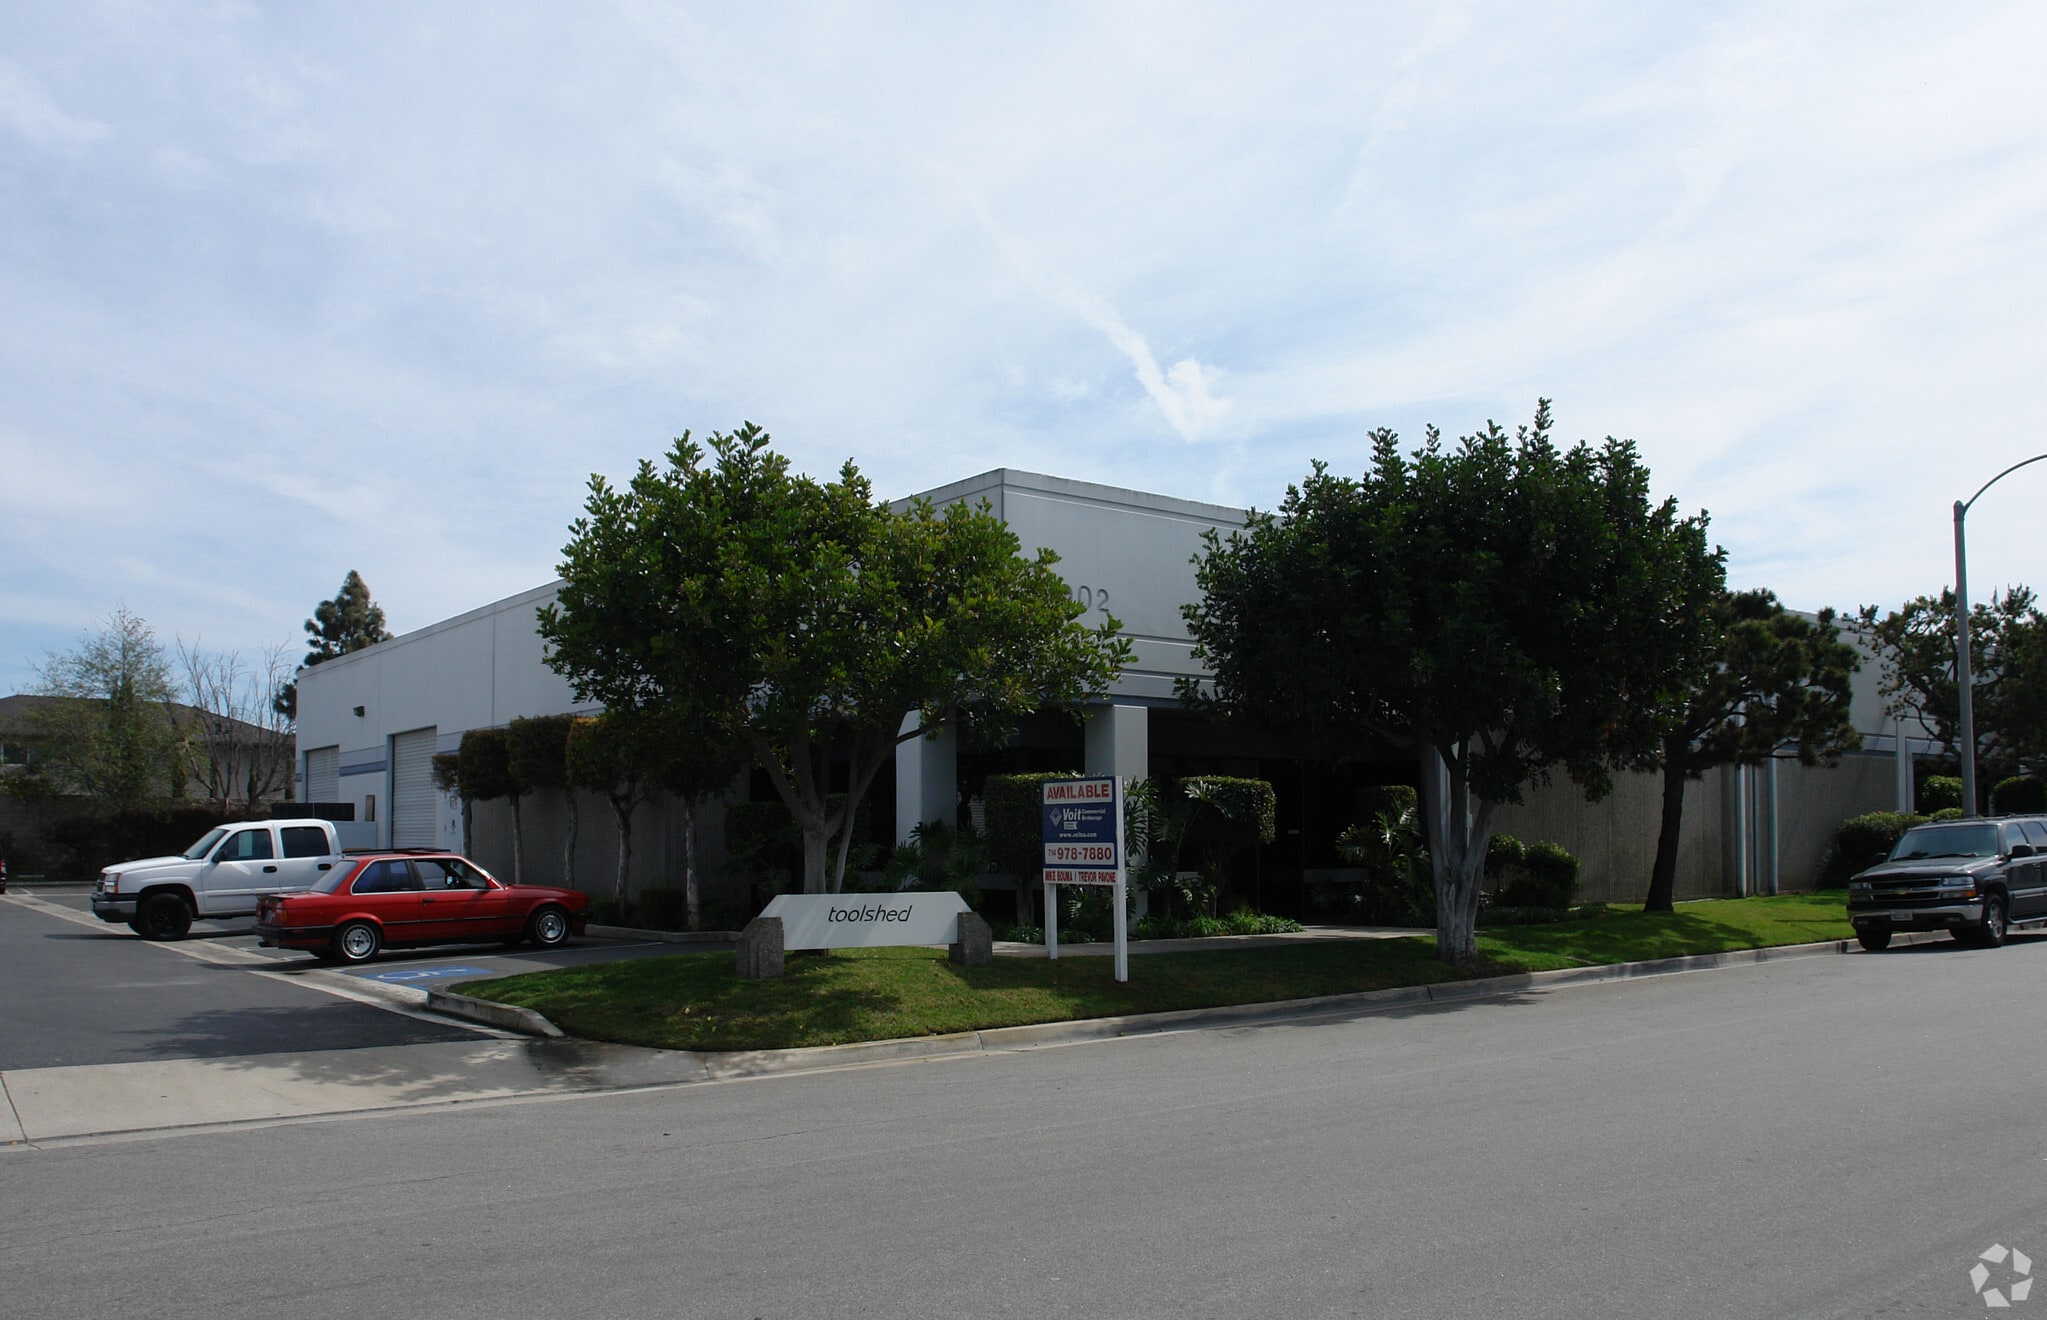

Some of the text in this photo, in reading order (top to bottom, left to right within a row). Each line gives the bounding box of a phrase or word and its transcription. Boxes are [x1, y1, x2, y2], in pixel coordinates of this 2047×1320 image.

[1065, 583, 1109, 612] 02
[1047, 784, 1110, 800] AVAILABLE
[1063, 808, 1081, 821] Voit
[1048, 847, 1112, 861] 714 978-7880
[828, 904, 913, 923] toolshed
